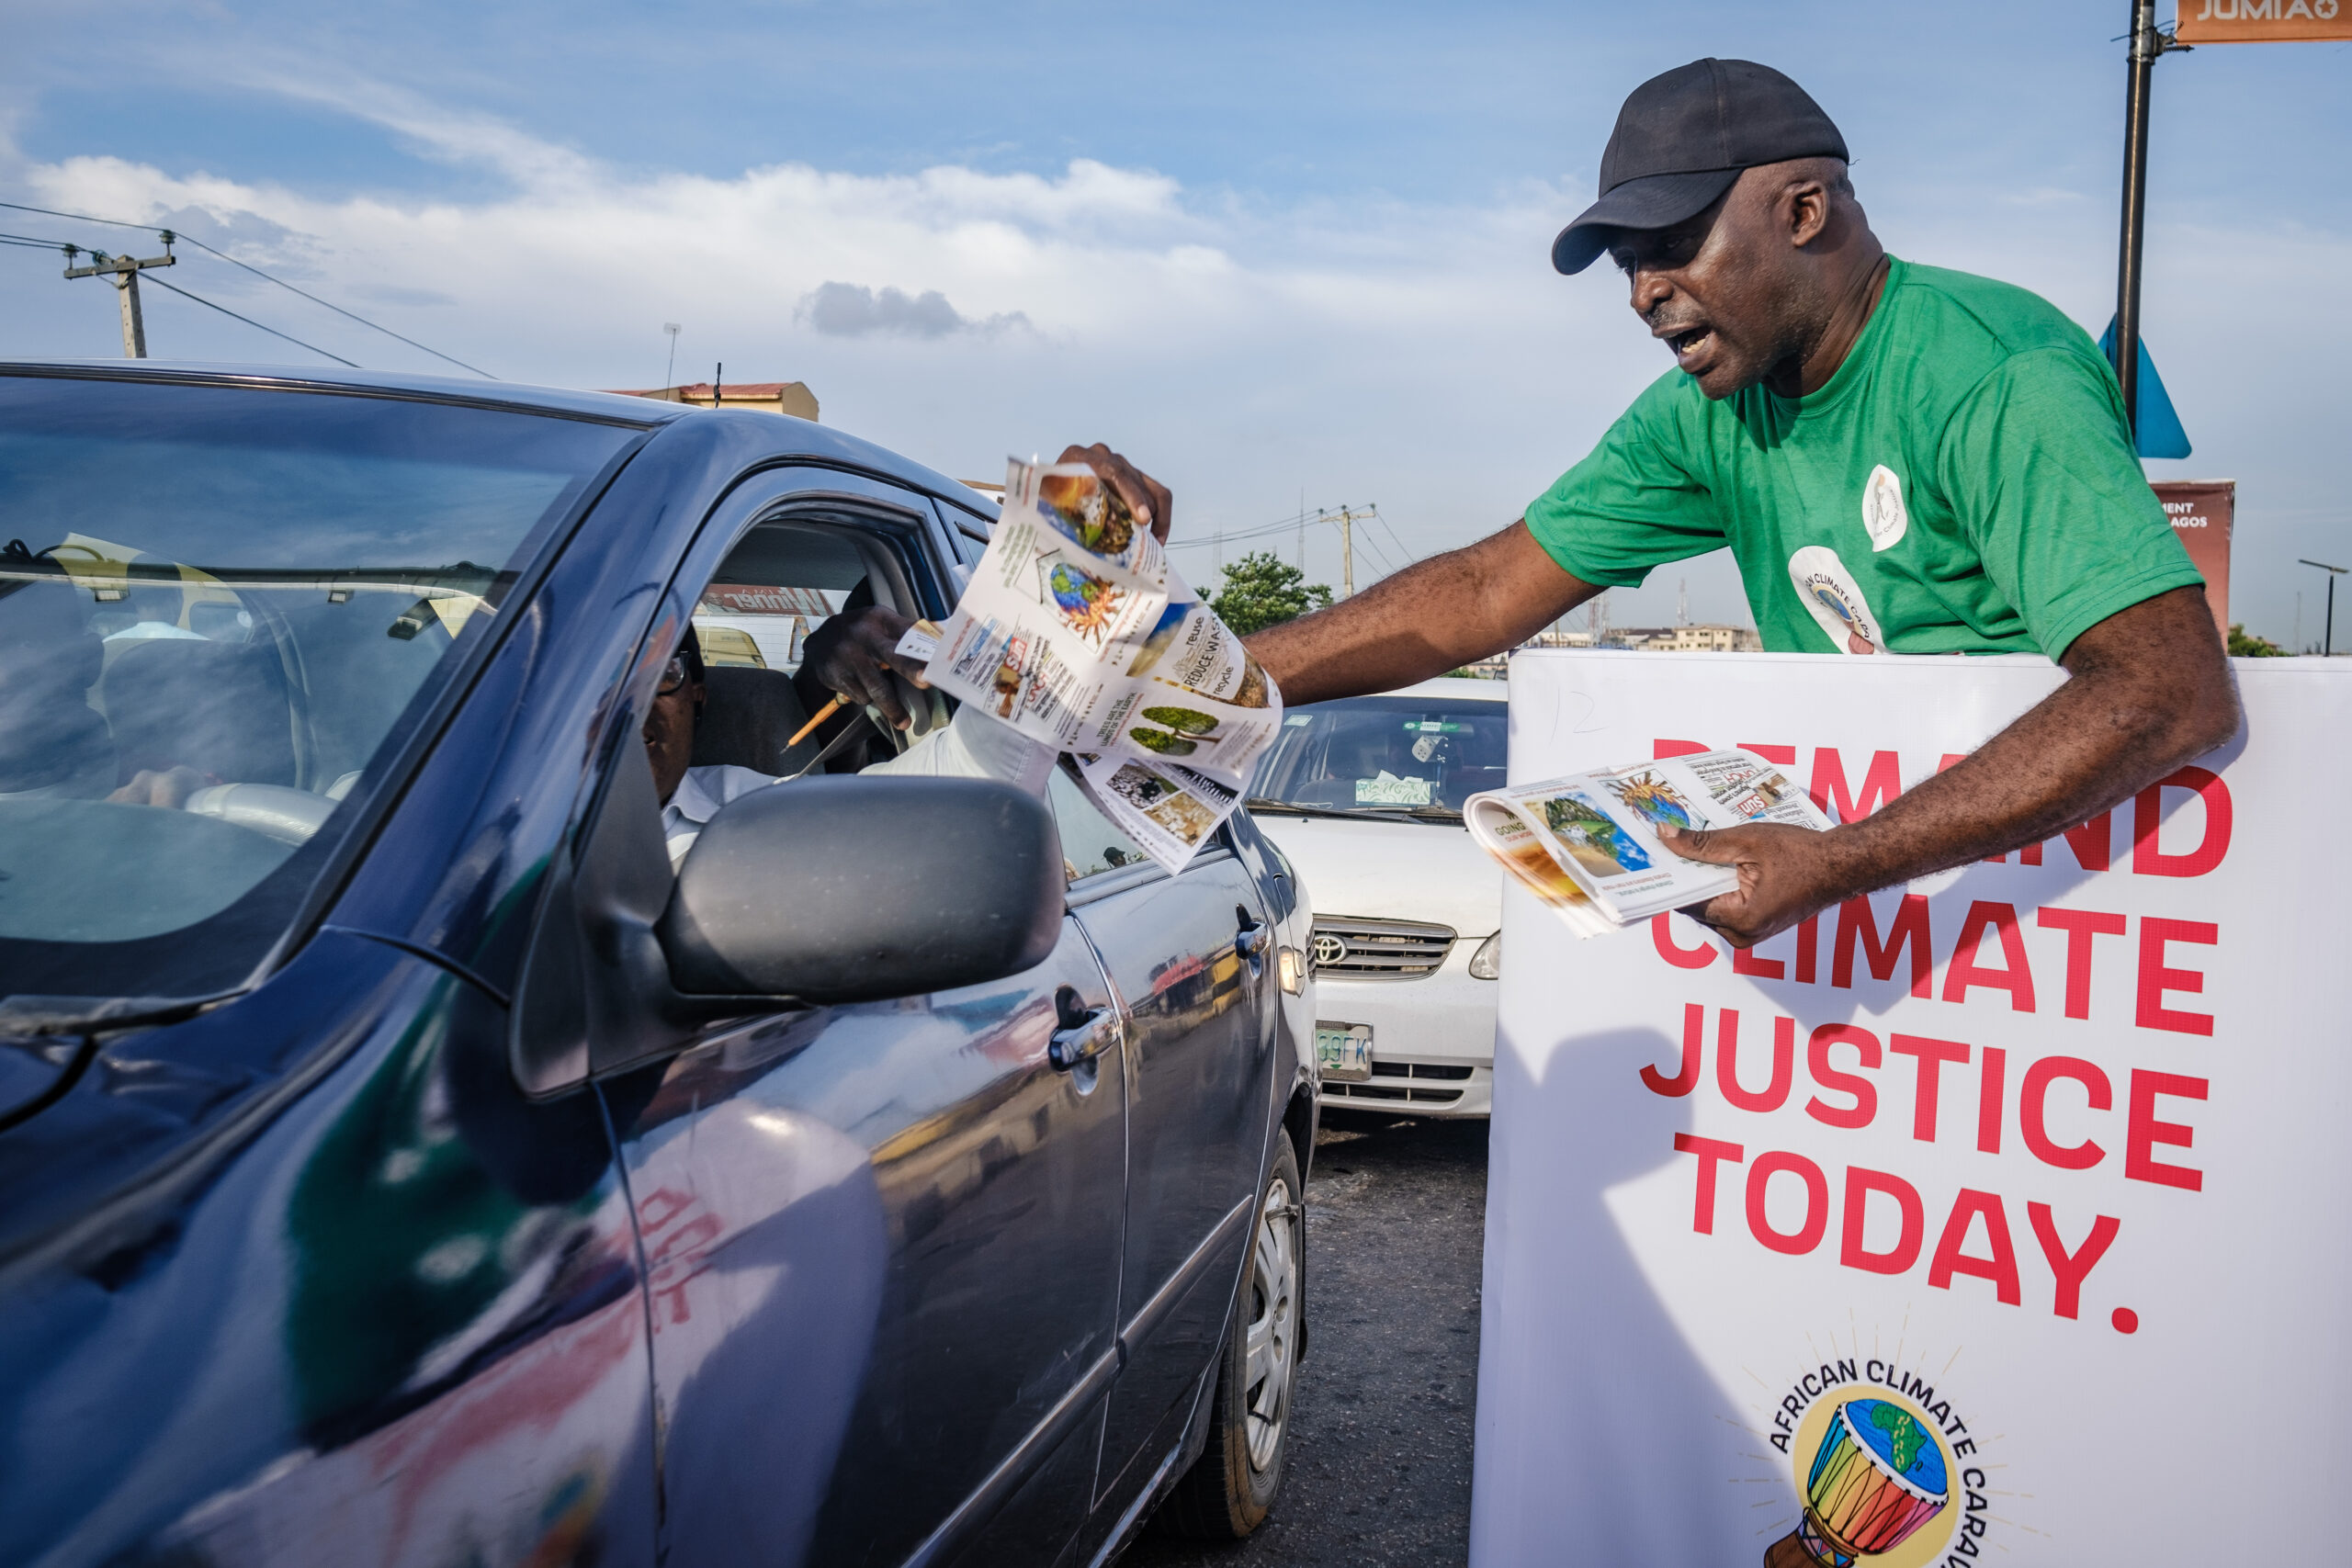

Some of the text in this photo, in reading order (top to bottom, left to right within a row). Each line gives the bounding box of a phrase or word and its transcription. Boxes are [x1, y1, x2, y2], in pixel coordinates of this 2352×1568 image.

[2171, 517, 2207, 527] AGOS
[1815, 573, 1850, 604] CLIMATE
[1185, 616, 1204, 647] reuse
[1005, 640, 1028, 670] Sun
[1183, 652, 1214, 687] REDUCE
[1213, 668, 1234, 695] recycle
[1113, 698, 1124, 708] THE
[1115, 710, 1126, 719] THE
[1724, 770, 1755, 784] UNCH
[1741, 795, 1765, 815] Sun
[1496, 822, 1526, 835] GOING
[1651, 891, 2220, 1037] CLIMATE
[1639, 1003, 2210, 1192] JUSTICE
[1673, 1133, 2139, 1335] TODAY.
[1770, 1359, 1859, 1454] AFRICAN
[1866, 1359, 1977, 1460] CLIMATE
